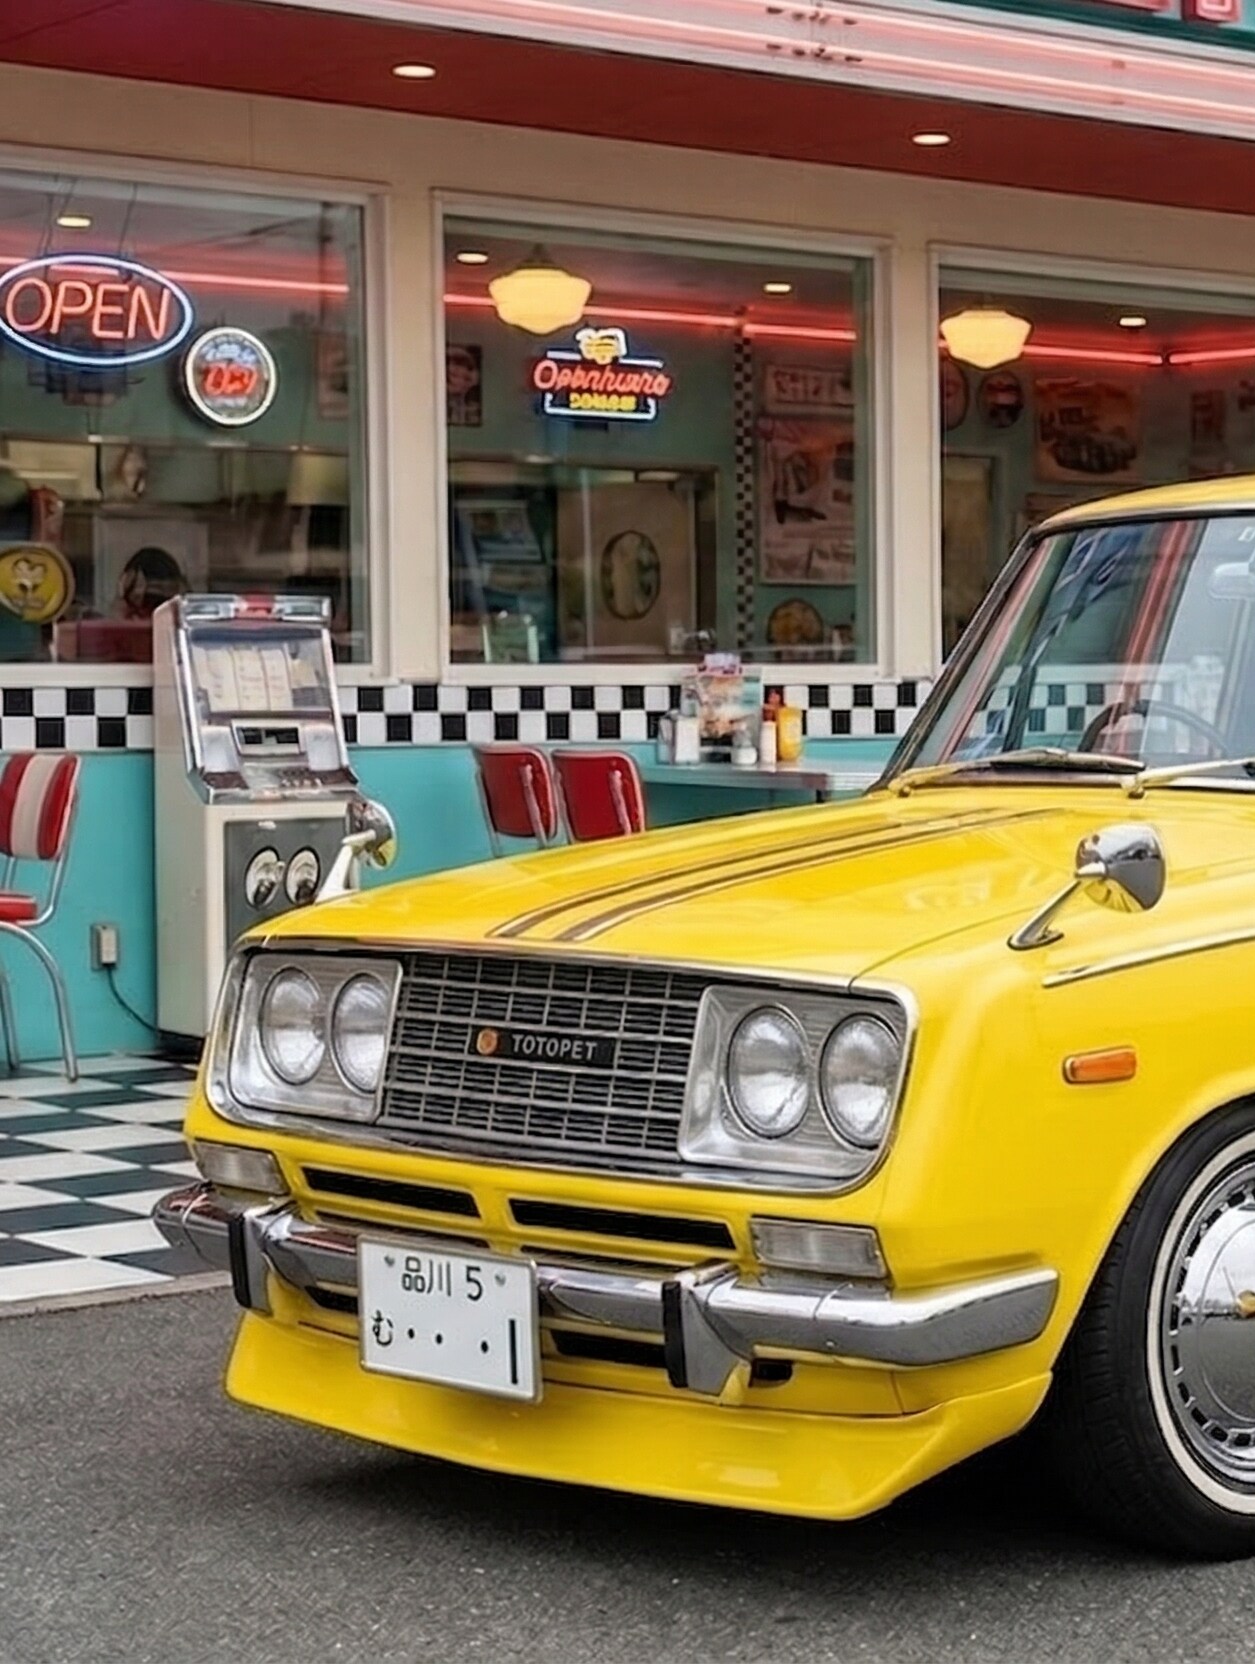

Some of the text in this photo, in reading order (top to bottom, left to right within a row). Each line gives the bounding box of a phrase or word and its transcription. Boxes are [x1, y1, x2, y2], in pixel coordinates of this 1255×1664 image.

[5, 277, 171, 340] OPEN
[512, 1033, 598, 1061] TOTOPET
[402, 1256, 484, 1301] 品川 5
